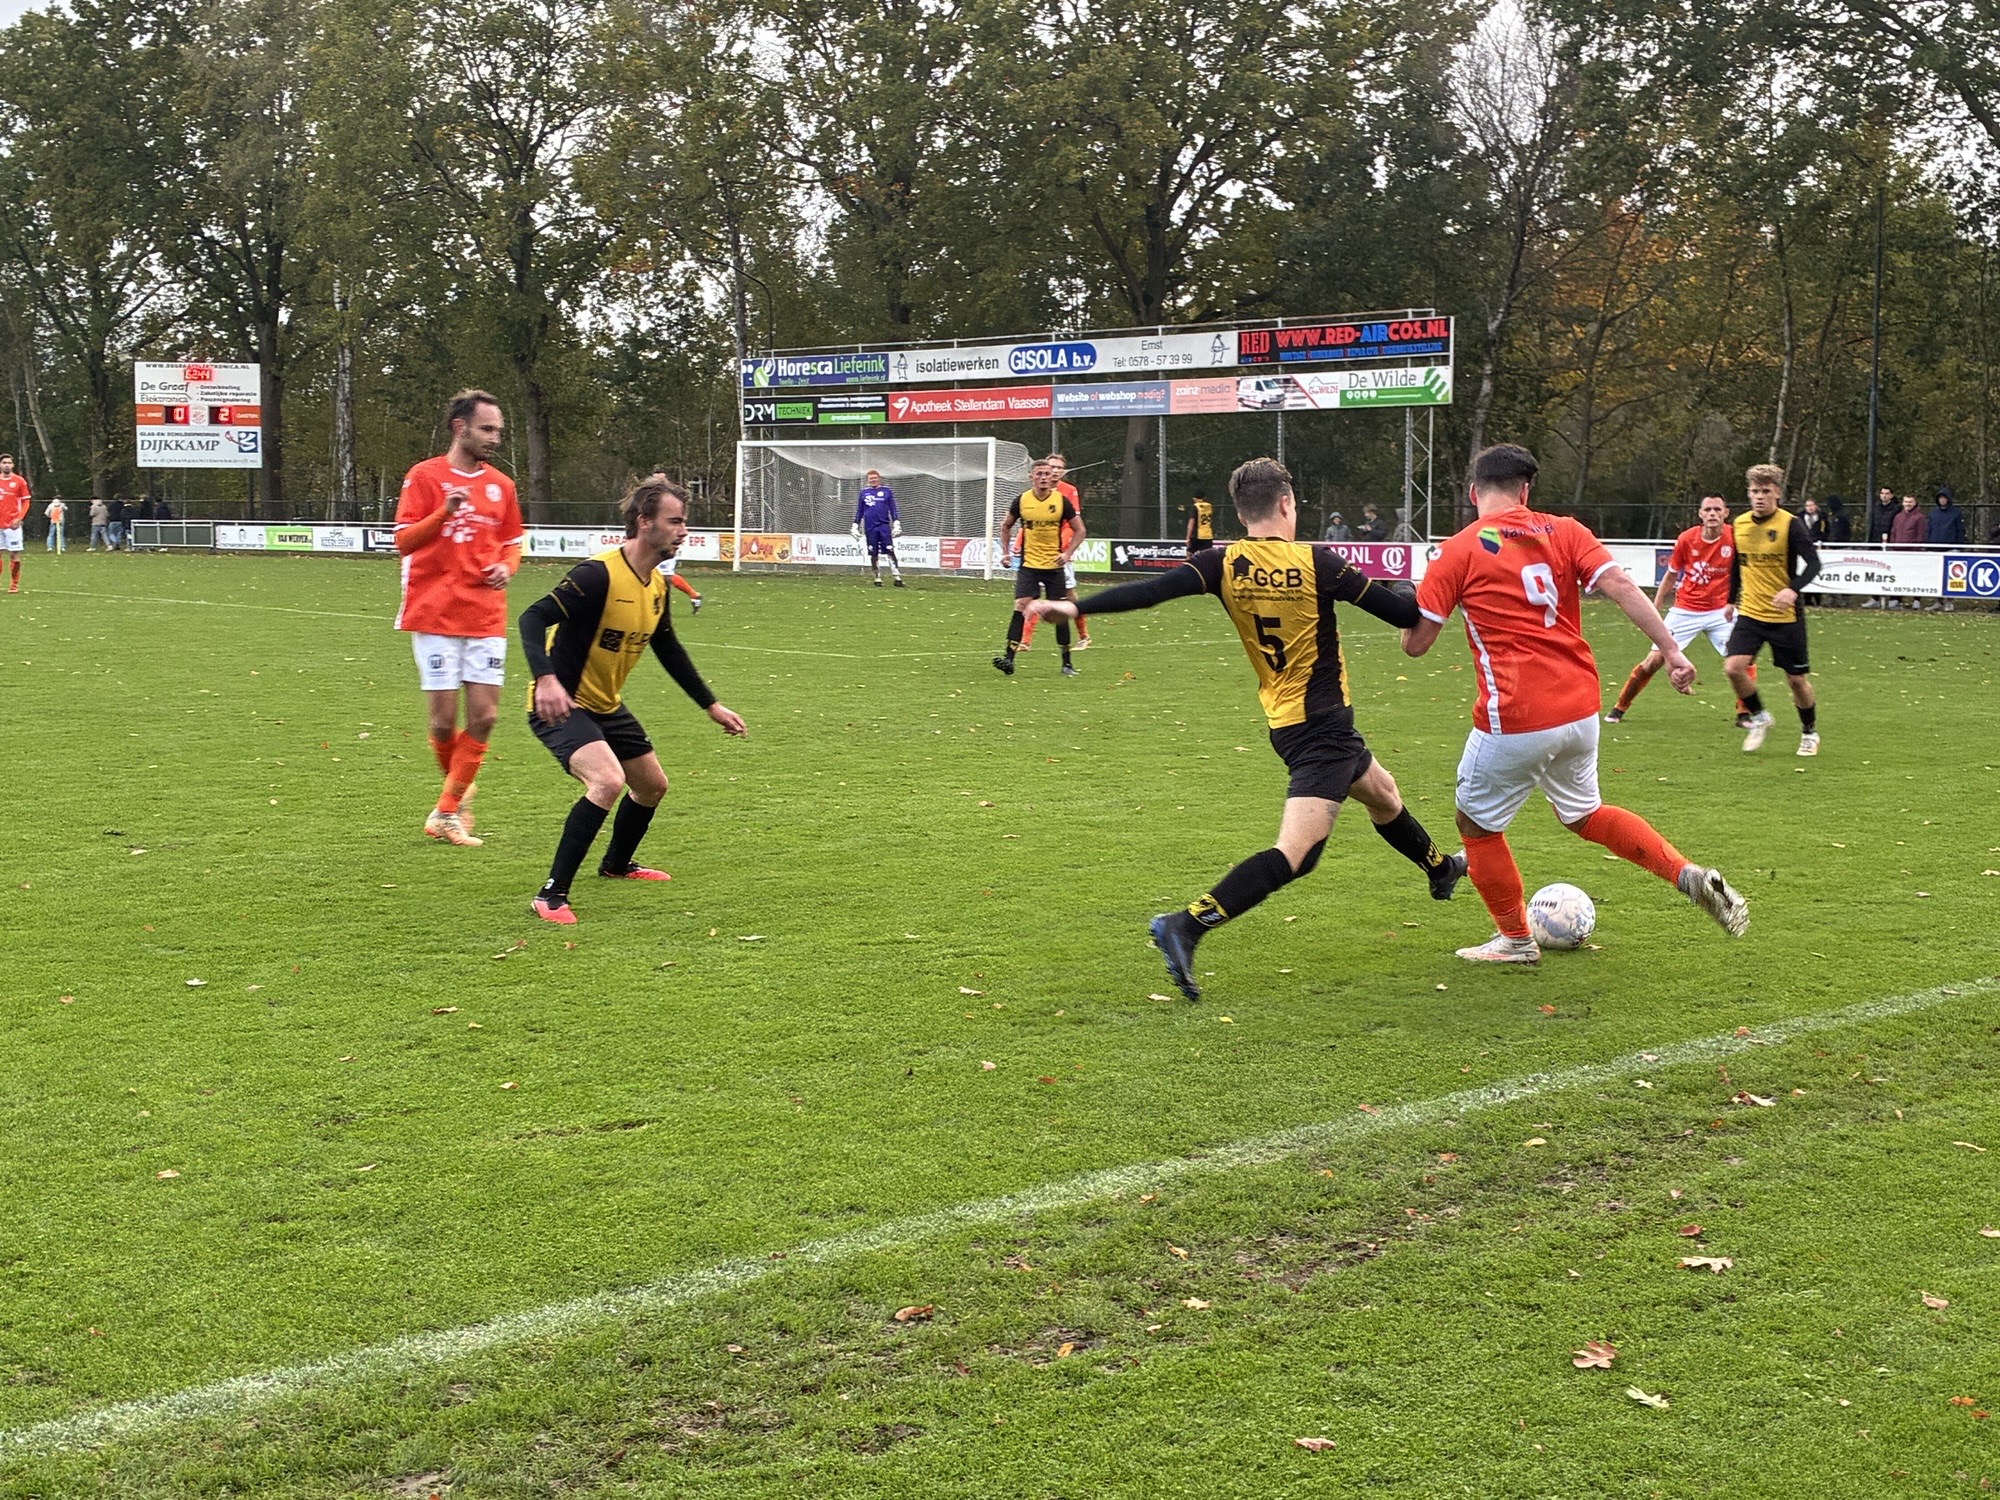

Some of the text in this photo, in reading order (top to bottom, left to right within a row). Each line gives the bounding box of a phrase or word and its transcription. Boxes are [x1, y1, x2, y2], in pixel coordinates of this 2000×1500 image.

[1275, 319, 1449, 348] WWW.RED-AIRCOS.NL
[1241, 332, 1270, 354] RED
[777, 354, 886, 377] Horesca Lieferink
[916, 348, 1094, 373] isolatiewerken GISOLA b.v.
[1113, 357, 1127, 368] Tel:
[1128, 355, 1149, 367] 0578
[1156, 354, 1168, 366] 57
[1169, 353, 1181, 365] 39
[1181, 353, 1193, 364] 99
[140, 381, 190, 393] De Graaf
[1348, 370, 1417, 388] De Wilde
[910, 399, 951, 416] Apotheek
[954, 397, 1006, 412] Stellendam
[1007, 396, 1049, 410] Vaassen
[1057, 392, 1090, 403] Website
[1098, 391, 1137, 403] webshop
[173, 408, 185, 421] 0
[218, 408, 230, 421] 2
[744, 403, 776, 421] DRM
[777, 406, 812, 416] TECHNIEK
[140, 440, 220, 454] DIJKKAMP
[600, 535, 627, 545] GARA
[689, 536, 706, 547] EPE
[816, 543, 864, 558] Wesselink
[1074, 541, 1108, 562] RMS
[1254, 568, 1303, 588] GCB
[1844, 571, 1860, 582] de
[1865, 571, 1896, 583] Mars
[1976, 567, 1994, 588] K
[1520, 562, 1559, 628] 9
[1254, 613, 1288, 673] 5
